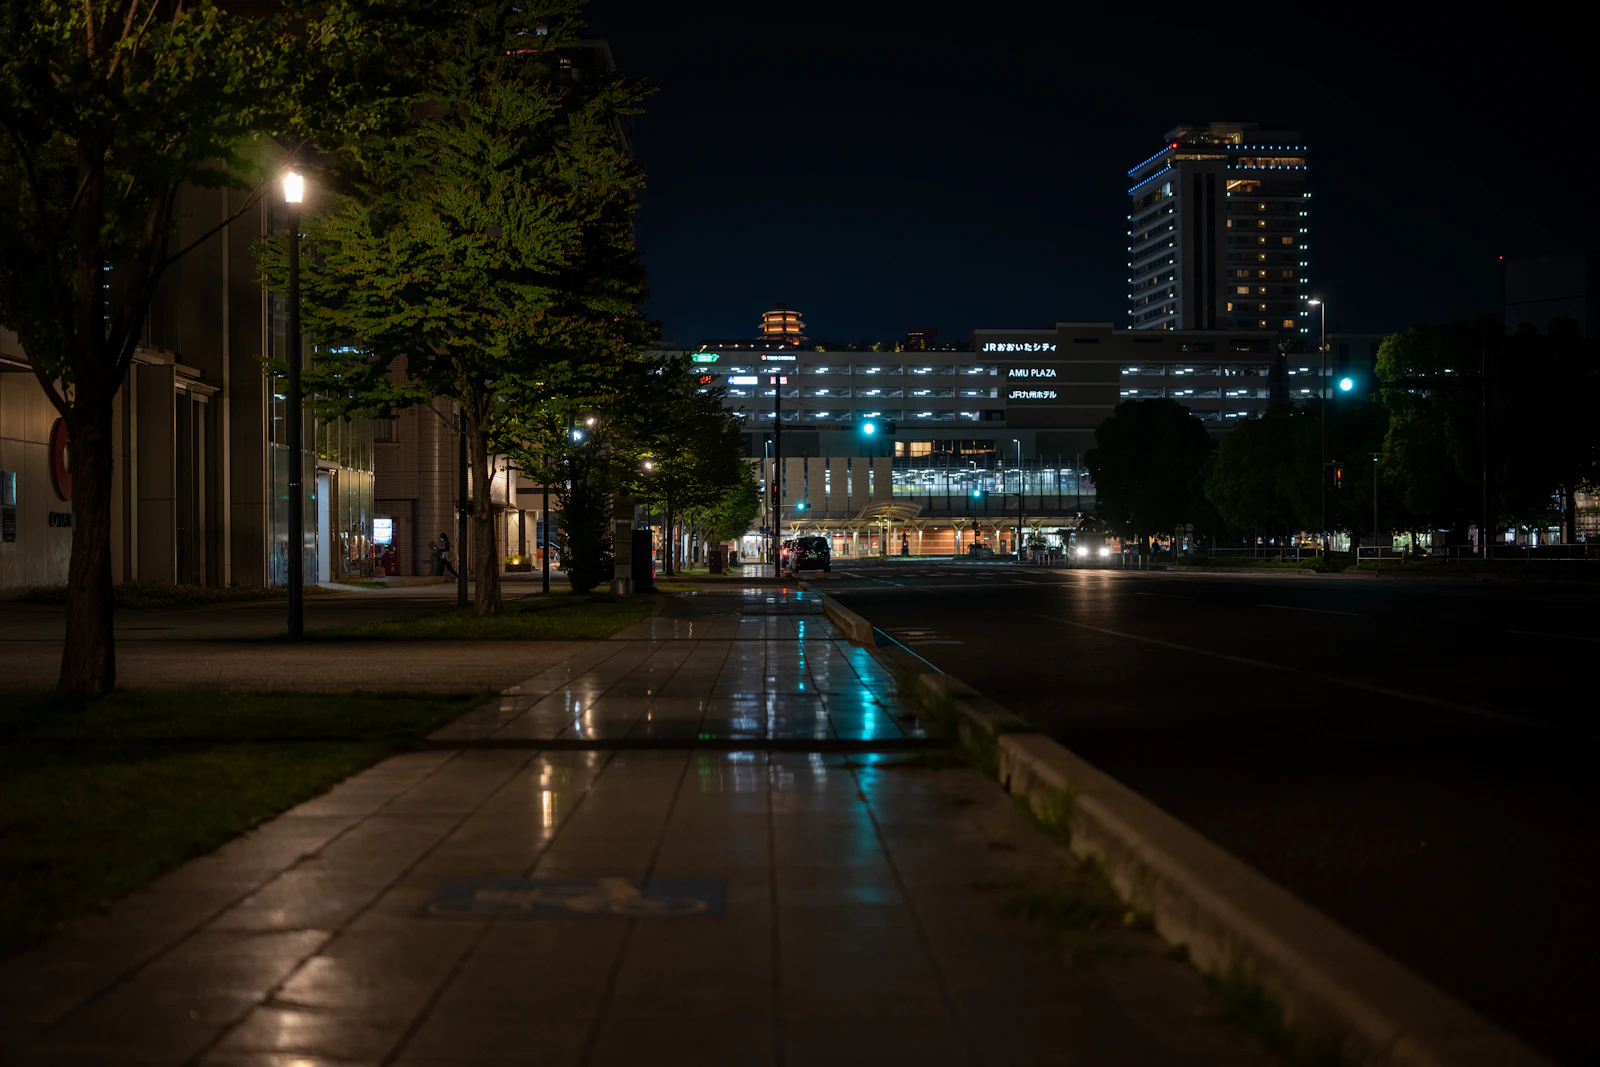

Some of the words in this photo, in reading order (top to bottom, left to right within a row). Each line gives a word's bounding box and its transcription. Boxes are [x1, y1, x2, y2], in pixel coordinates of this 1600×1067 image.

[982, 343, 1057, 352] JRおおいたシティ
[1008, 369, 1029, 377] AMU
[1031, 369, 1057, 377] PLAZA
[1008, 390, 1057, 399] JR九州ホテル
